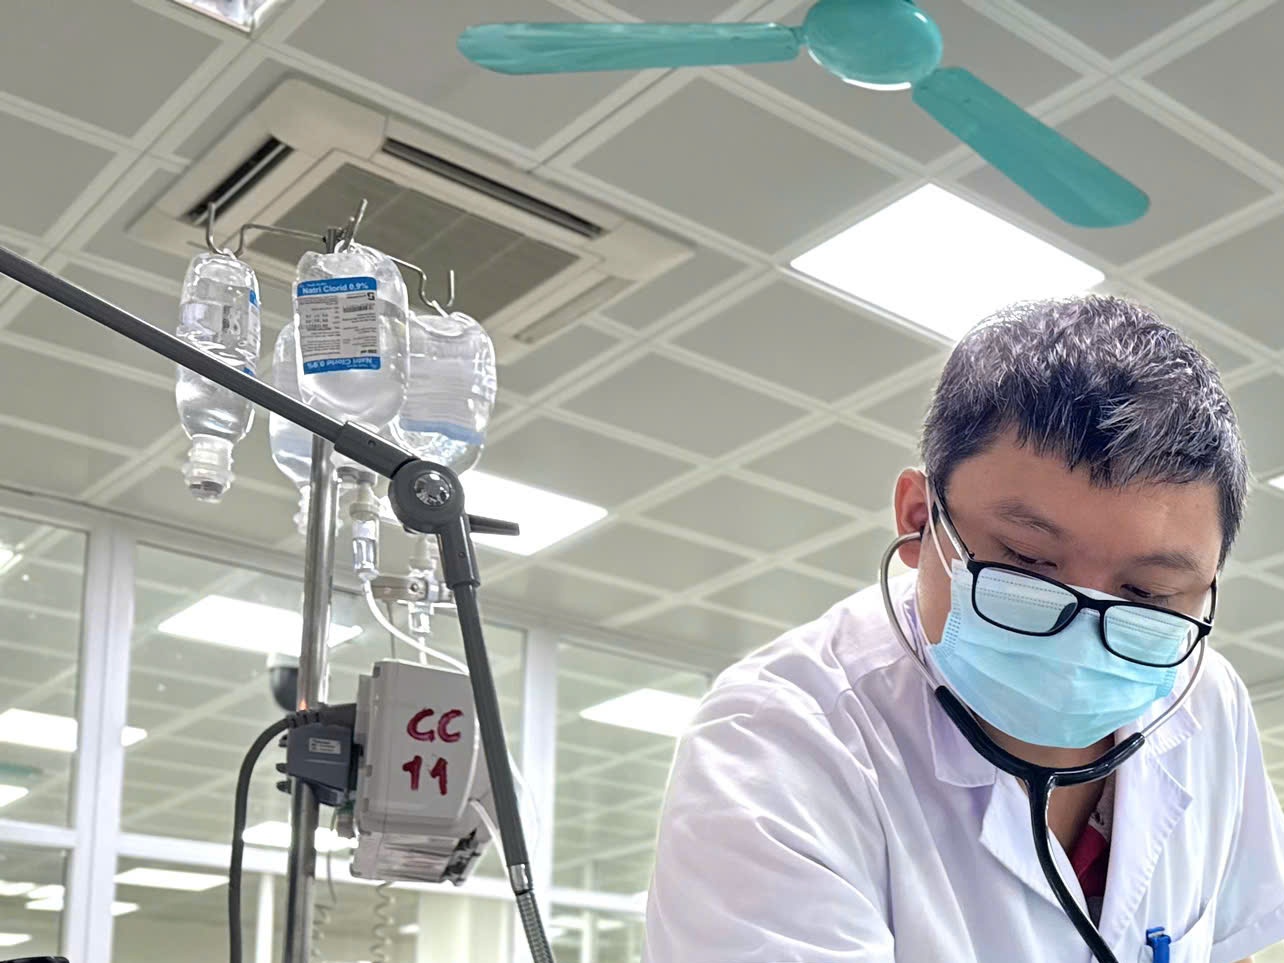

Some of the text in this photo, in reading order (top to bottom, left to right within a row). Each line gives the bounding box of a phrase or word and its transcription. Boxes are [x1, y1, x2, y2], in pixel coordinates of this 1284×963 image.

[302, 286, 322, 295] Natri
[323, 284, 348, 293] Clorid
[348, 281, 369, 290] 0.9%
[402, 755, 449, 795] 11
